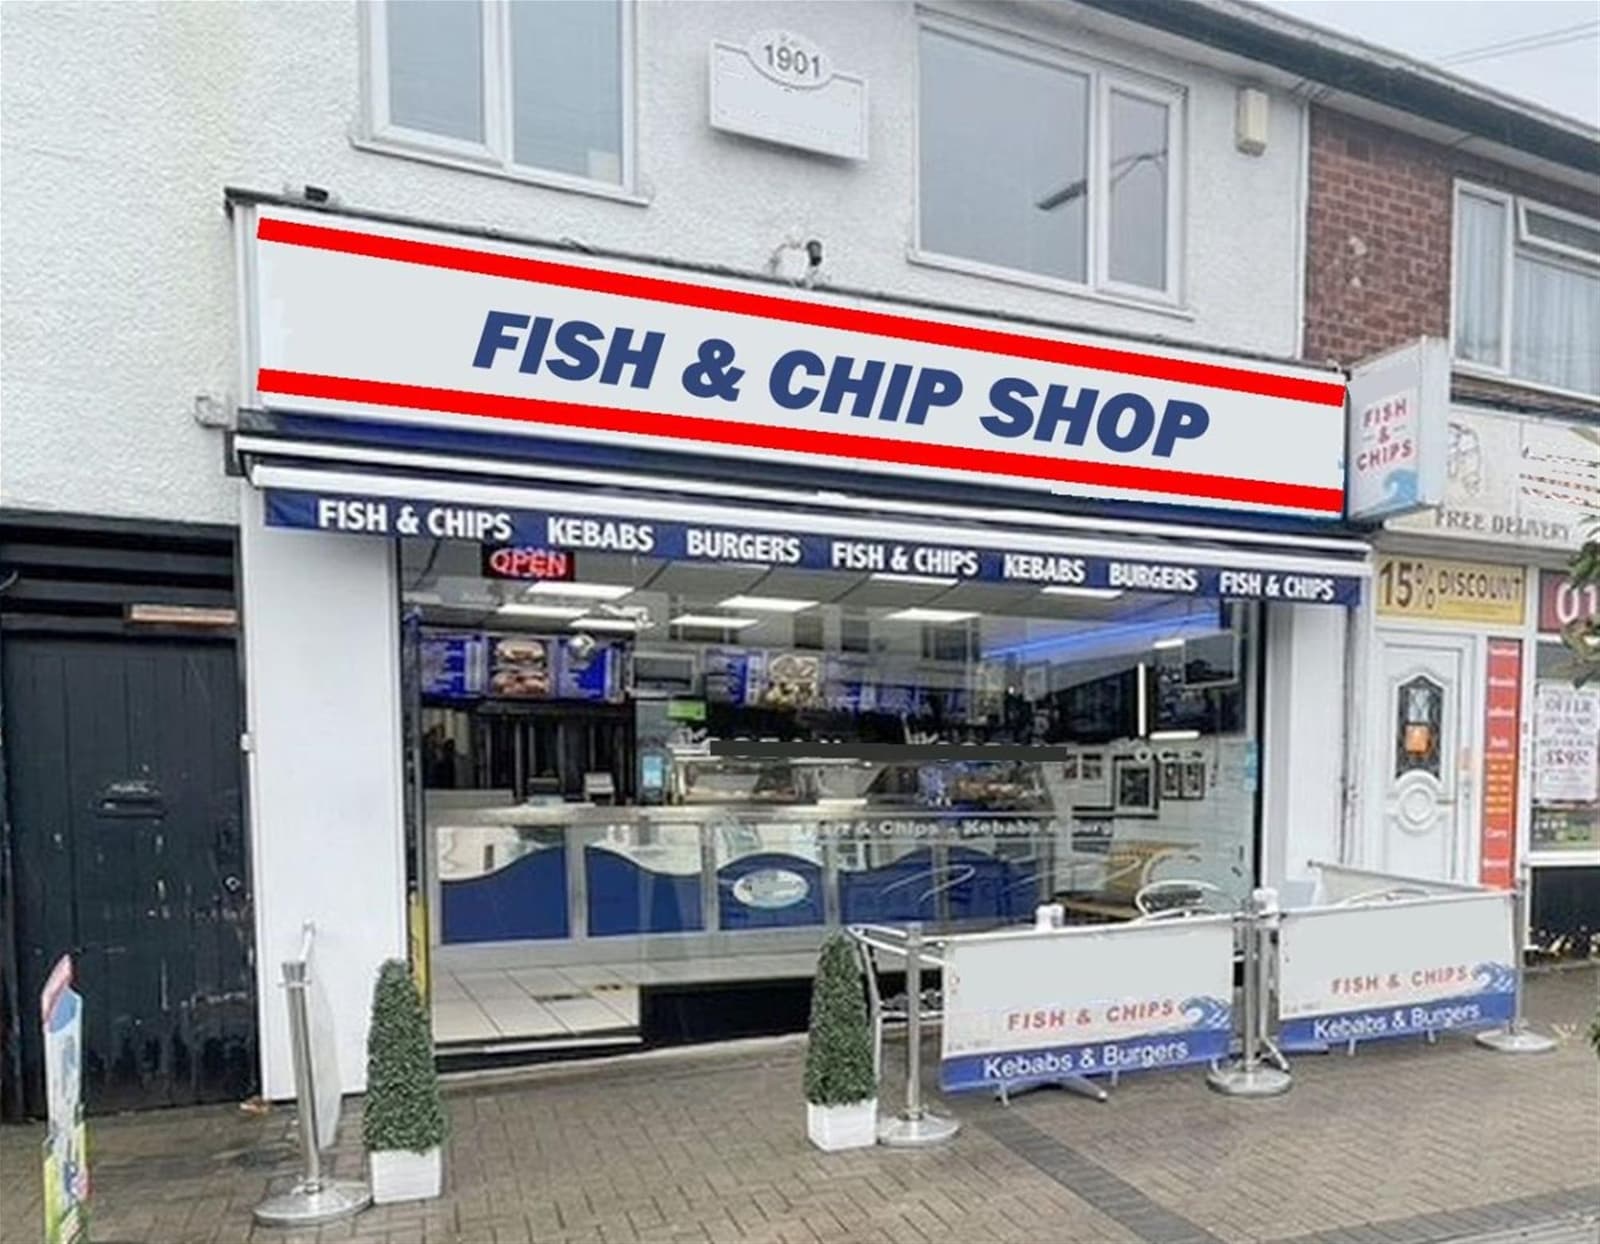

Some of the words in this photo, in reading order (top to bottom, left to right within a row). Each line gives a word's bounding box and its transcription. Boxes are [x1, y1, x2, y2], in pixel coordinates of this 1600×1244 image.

[765, 44, 820, 78] 1901
[472, 310, 666, 390] FISH
[681, 338, 745, 402] &
[768, 349, 963, 425] CHIP
[979, 377, 1210, 458] SHOP
[1363, 398, 1407, 428] FISH
[1378, 426, 1390, 444] &
[1356, 438, 1412, 471] CHIPS
[1435, 508, 1485, 531] FREE
[1491, 515, 1570, 543] DELIVERY
[318, 499, 388, 533] FISH
[396, 506, 419, 536] &
[427, 507, 512, 541] CHIPS
[547, 517, 654, 552] KEBABS
[686, 528, 801, 564] BURGERS
[831, 541, 884, 569] FISH
[889, 546, 909, 572] &
[912, 547, 979, 576] CHIPS
[1003, 553, 1086, 583] KEBABS
[1108, 562, 1198, 592] BURGERS
[1220, 571, 1262, 595] FISH
[1264, 576, 1281, 597] &
[1283, 578, 1336, 601] CHIPS
[489, 549, 567, 578] OPEN
[1438, 569, 1521, 600] DISCOUNT
[1331, 977, 1379, 994] FISH
[1386, 974, 1400, 988] &
[1411, 965, 1467, 987] CHIPS
[1007, 1009, 1065, 1031] FISH
[1076, 1009, 1092, 1026] &
[1106, 1000, 1173, 1023] CHIPS
[1312, 1014, 1388, 1041] Kebabs
[1391, 1009, 1406, 1031] &
[1410, 1002, 1481, 1030] Burgers
[983, 1051, 1073, 1079] Kebabs
[1079, 1048, 1096, 1070] &
[1103, 1040, 1190, 1069] Burgers
